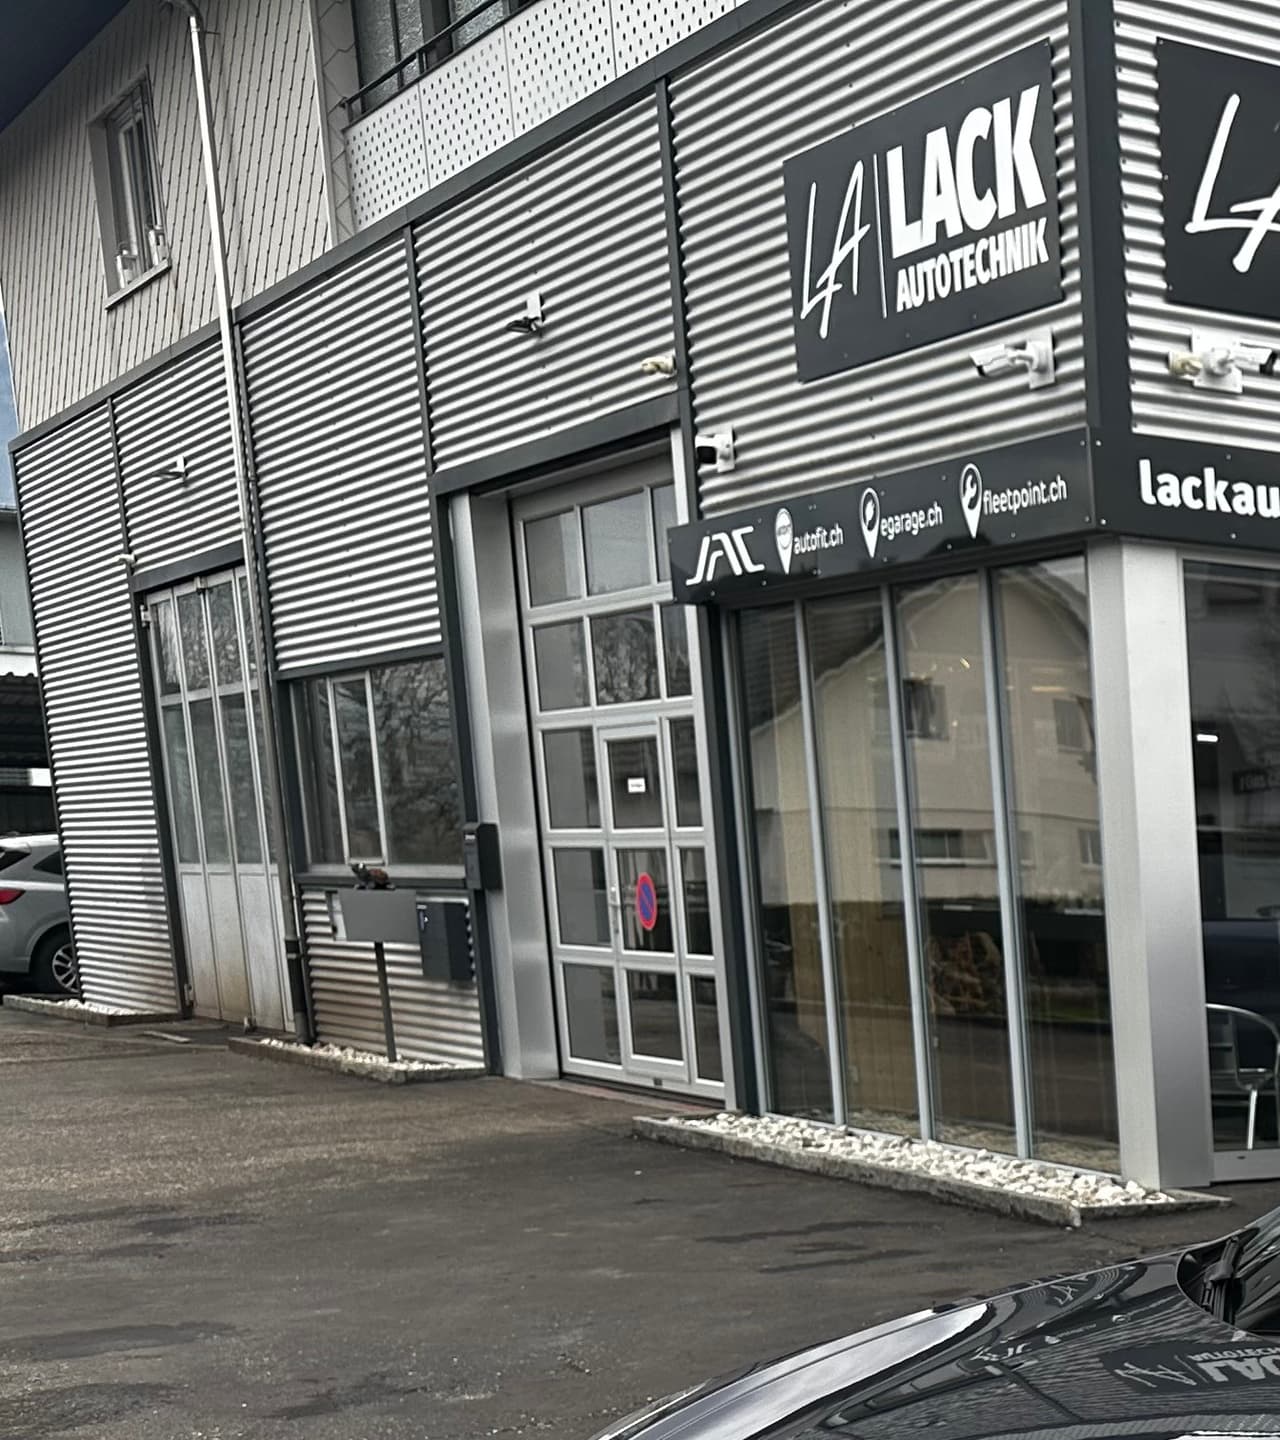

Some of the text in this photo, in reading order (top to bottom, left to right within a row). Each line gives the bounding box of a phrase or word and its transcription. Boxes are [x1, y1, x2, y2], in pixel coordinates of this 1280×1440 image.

[886, 84, 1047, 259] LACK
[896, 217, 1049, 312] AUTOTECHNIK
[794, 523, 844, 555] autofit.ch
[880, 502, 943, 540] egarage.ch
[983, 475, 1067, 515] fleetpoint.ch
